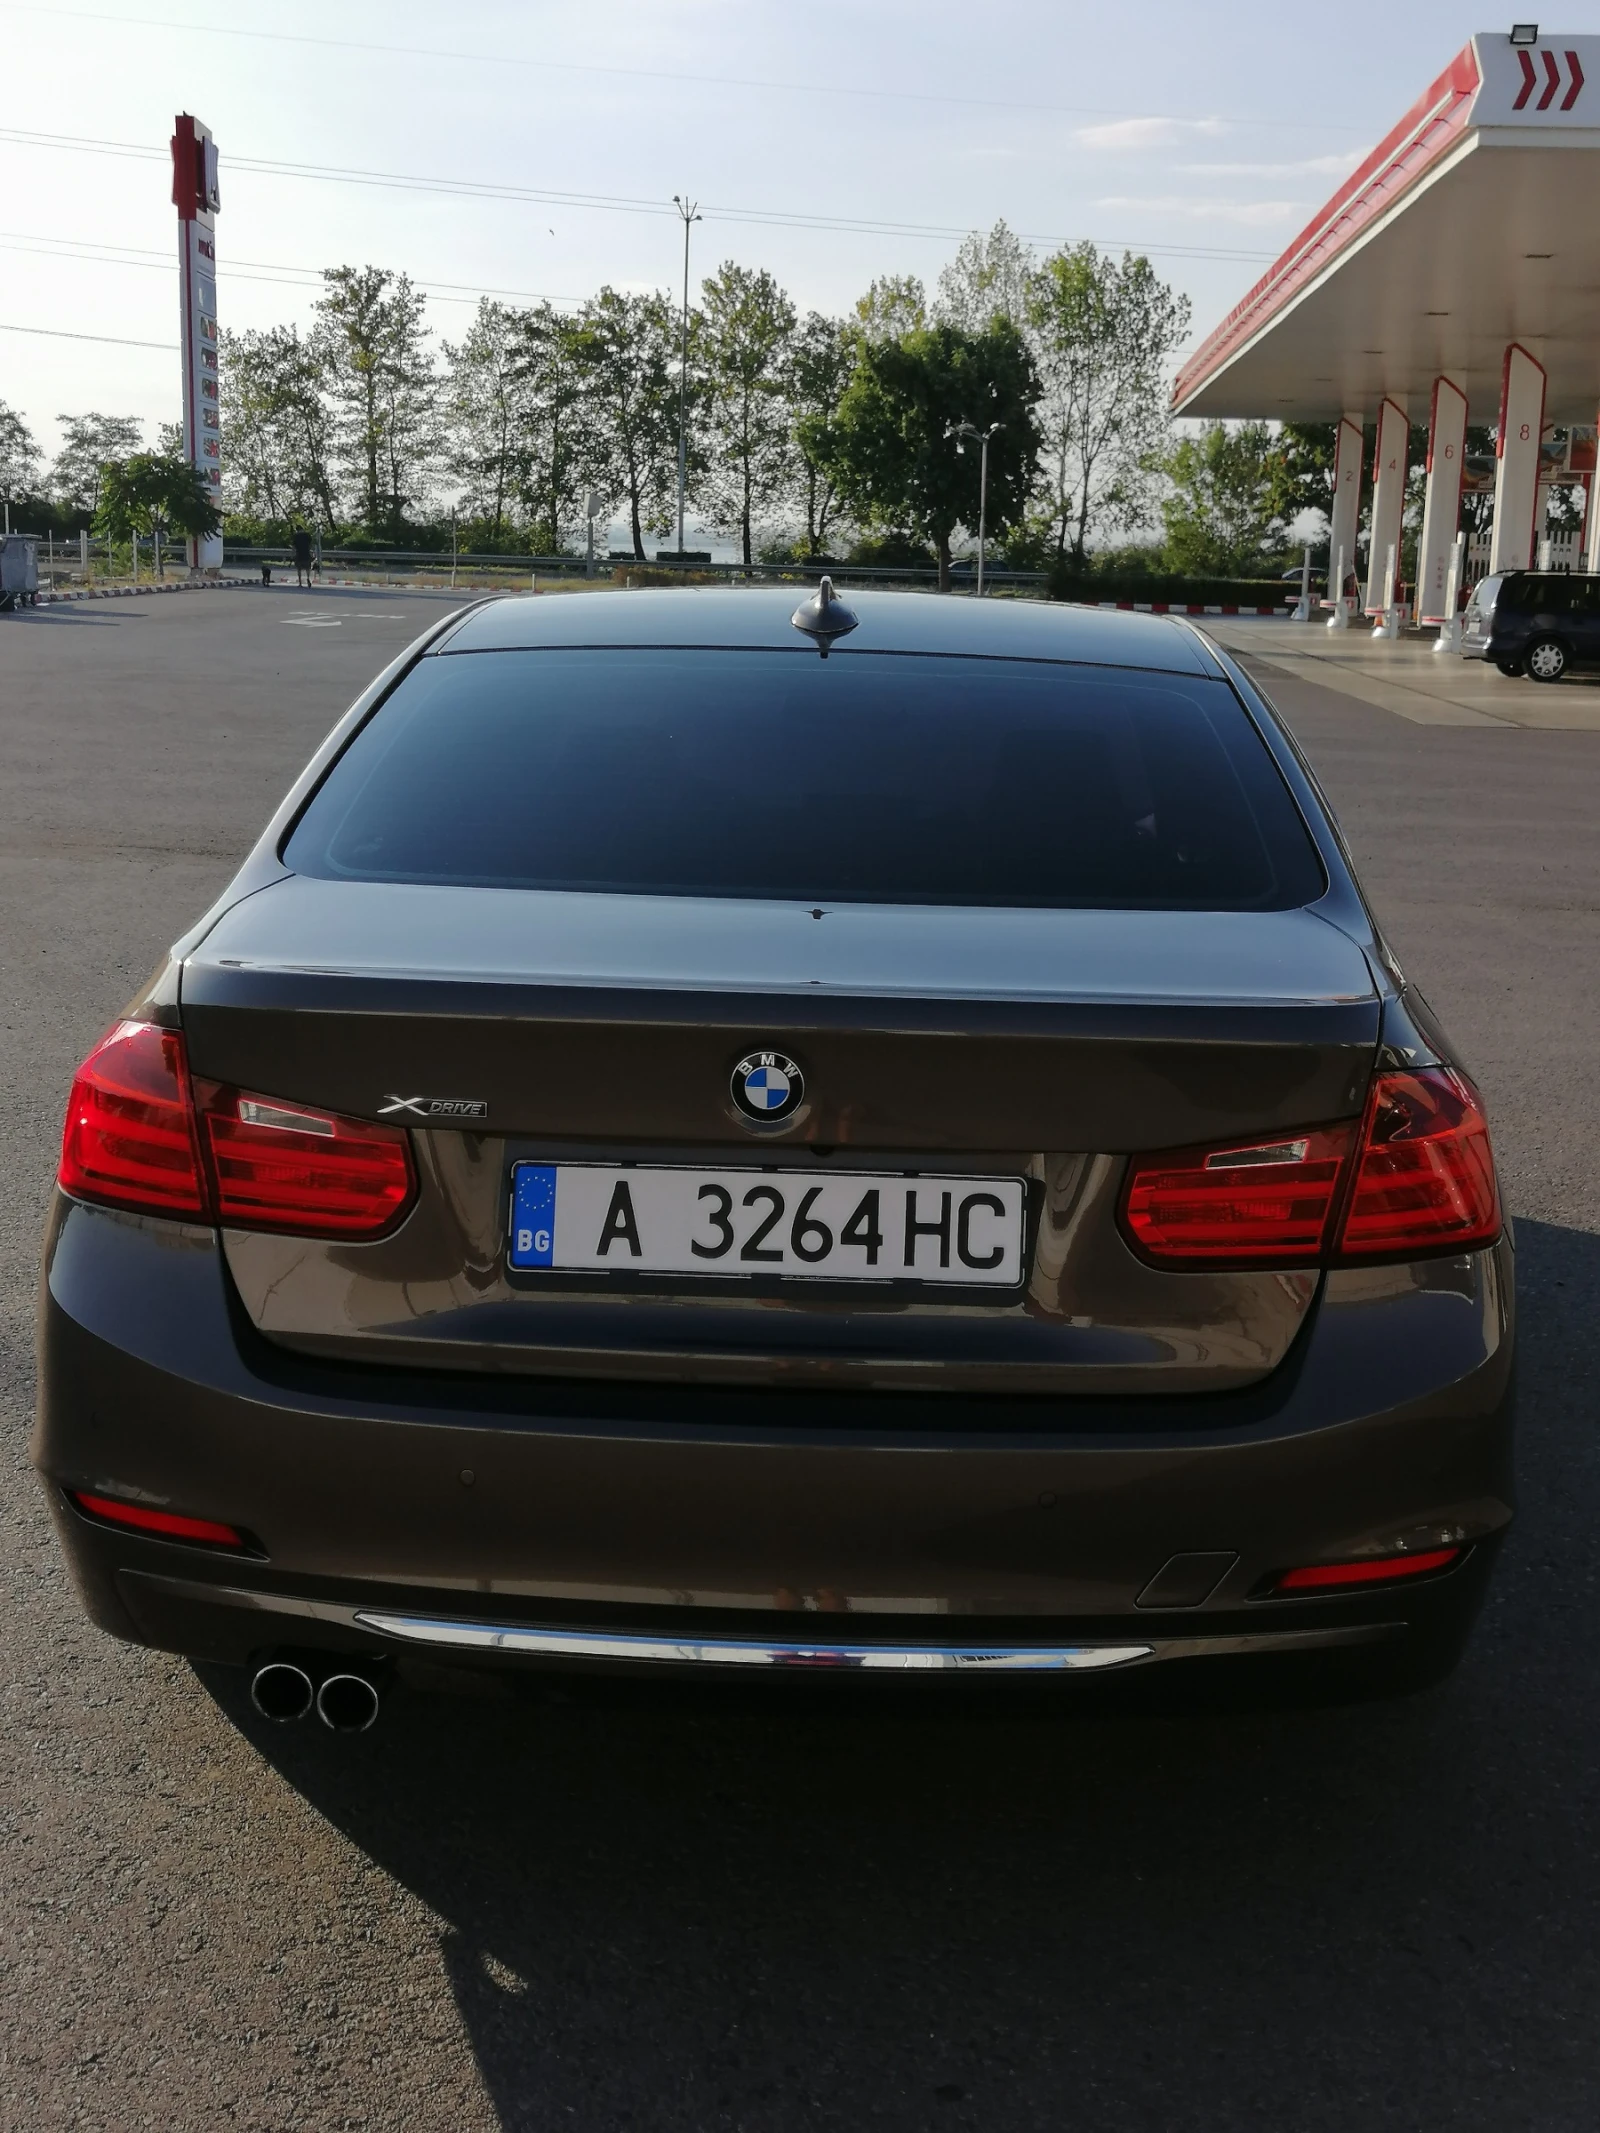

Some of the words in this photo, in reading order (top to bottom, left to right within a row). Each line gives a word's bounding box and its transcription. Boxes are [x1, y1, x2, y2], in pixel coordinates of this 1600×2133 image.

[1520, 424, 1529, 440] 8
[1445, 444, 1454, 459] 6
[1389, 458, 1396, 471] 4
[1345, 470, 1354, 482] 2
[738, 1054, 799, 1078] BMW
[517, 1228, 550, 1253] BG
[596, 1180, 643, 1257] A
[691, 1183, 884, 1266] 3264
[903, 1190, 1006, 1270] HC
